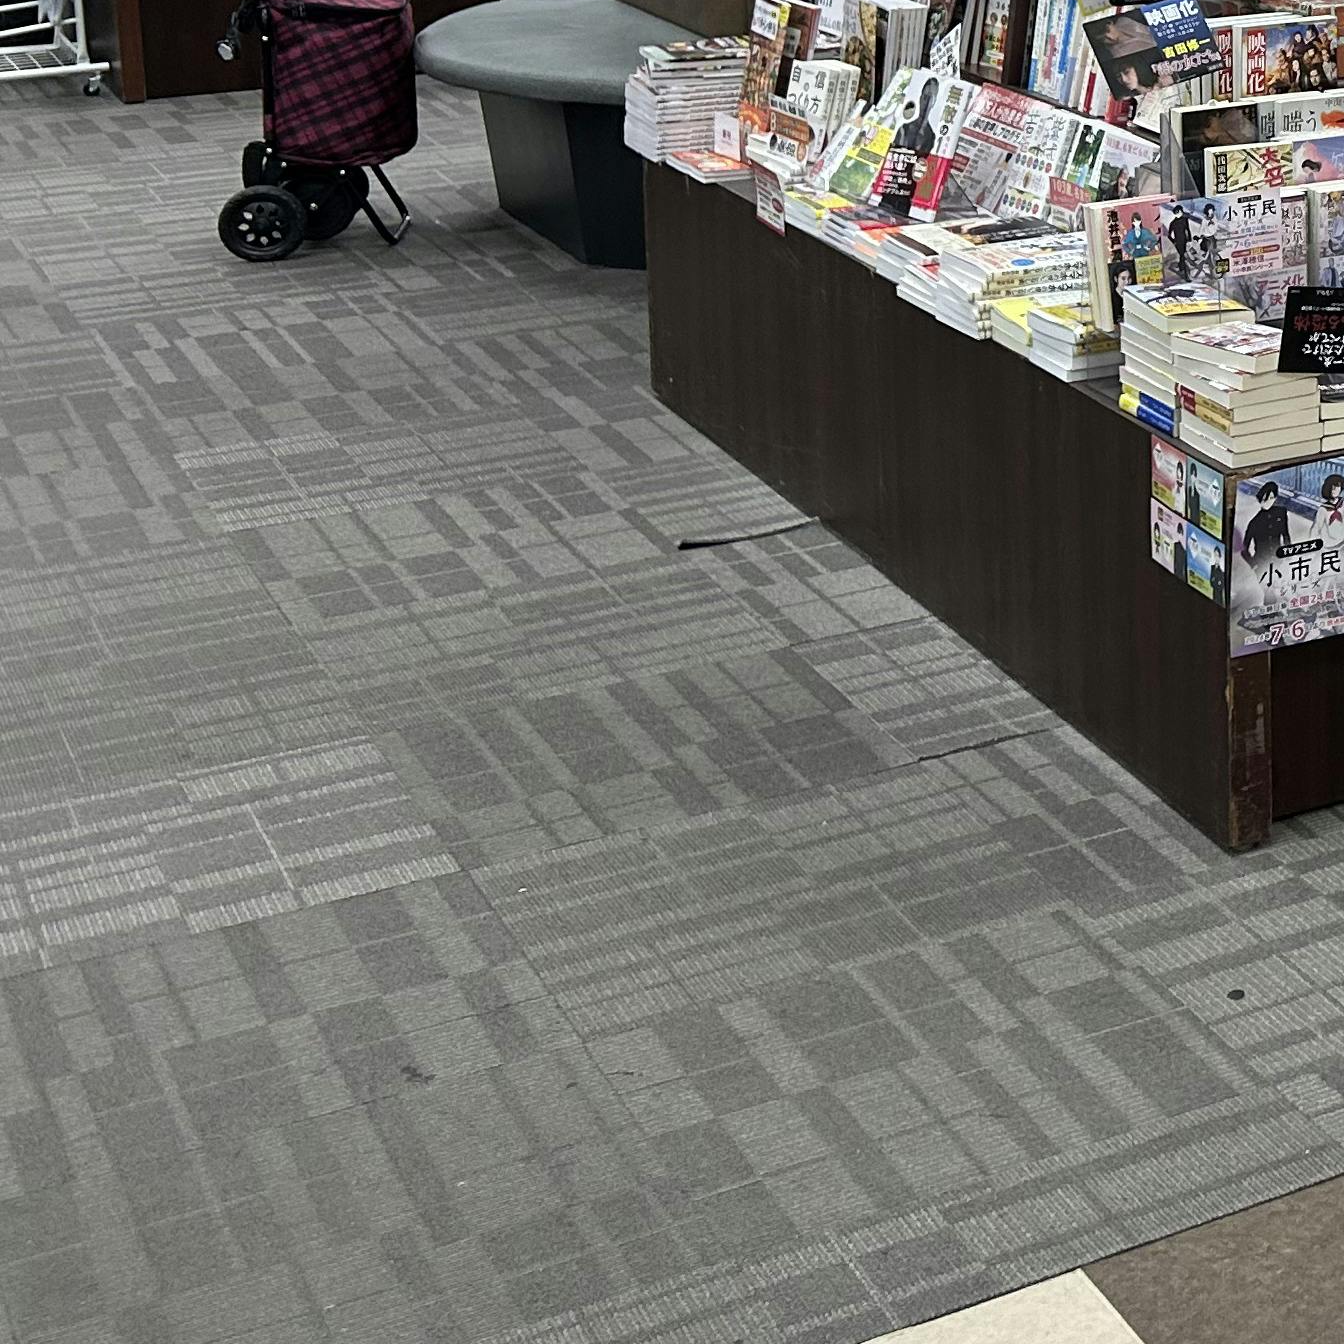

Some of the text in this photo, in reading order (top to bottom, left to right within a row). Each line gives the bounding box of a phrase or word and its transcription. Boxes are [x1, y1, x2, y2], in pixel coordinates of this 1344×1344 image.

[1143, 0, 1199, 27] 映画化
[1246, 31, 1266, 96] 映画化
[1223, 199, 1277, 222] 小市民
[1282, 541, 1318, 555] TVアニメ
[1259, 549, 1341, 587] 小市民
[1280, 579, 1320, 597] シリーズ
